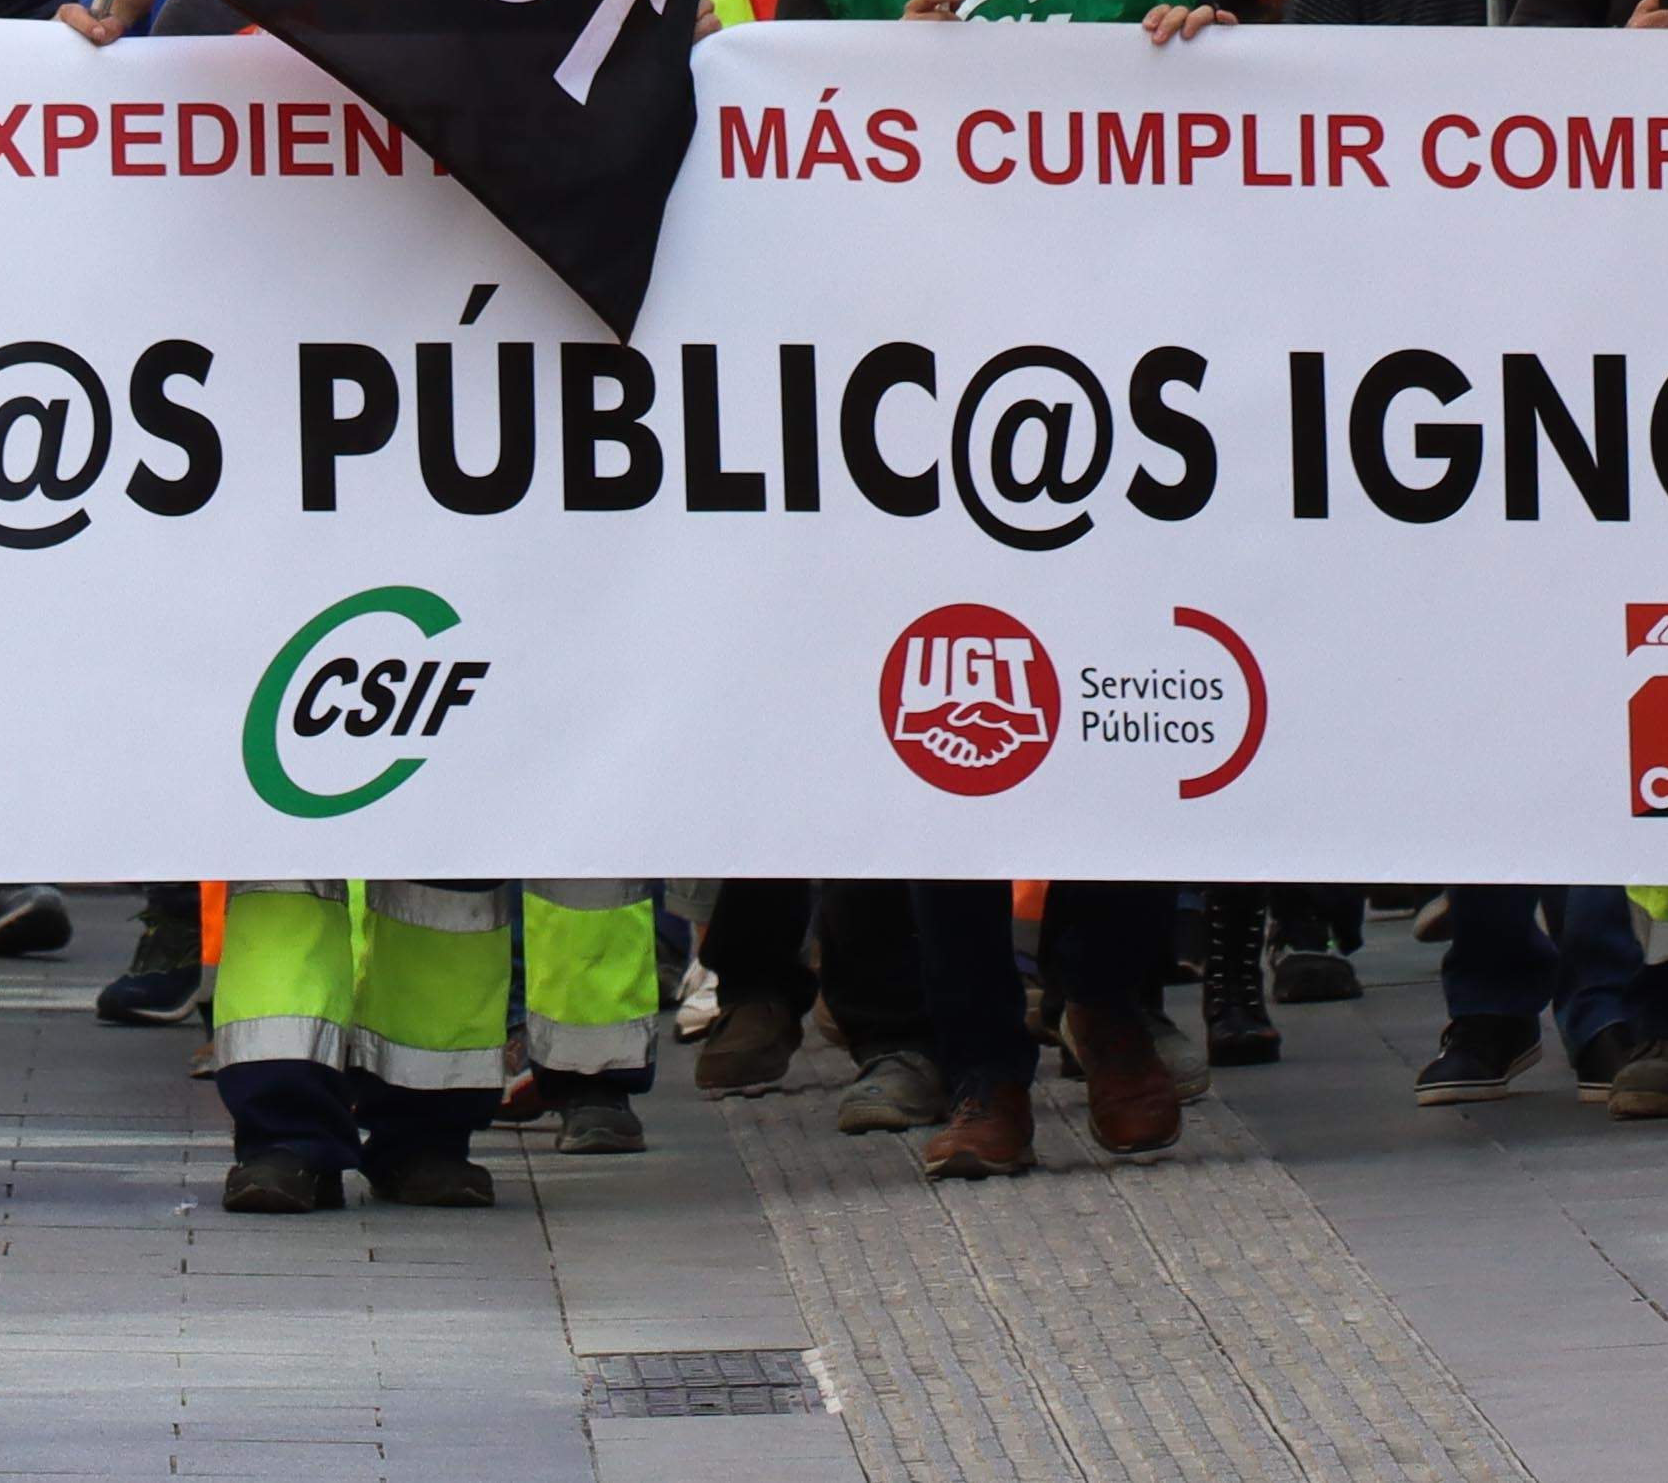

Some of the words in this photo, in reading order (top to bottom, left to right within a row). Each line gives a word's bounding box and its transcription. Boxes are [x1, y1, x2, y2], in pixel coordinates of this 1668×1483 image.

[719, 88, 922, 182] MÁS
[956, 109, 1389, 187] CUMPLIR
[297, 283, 1218, 552] PÚBLIC@S
[292, 656, 491, 738] CSIF
[907, 635, 1038, 708] UGT
[1081, 667, 1224, 702] Servicios
[1081, 708, 1216, 745] Públicos
